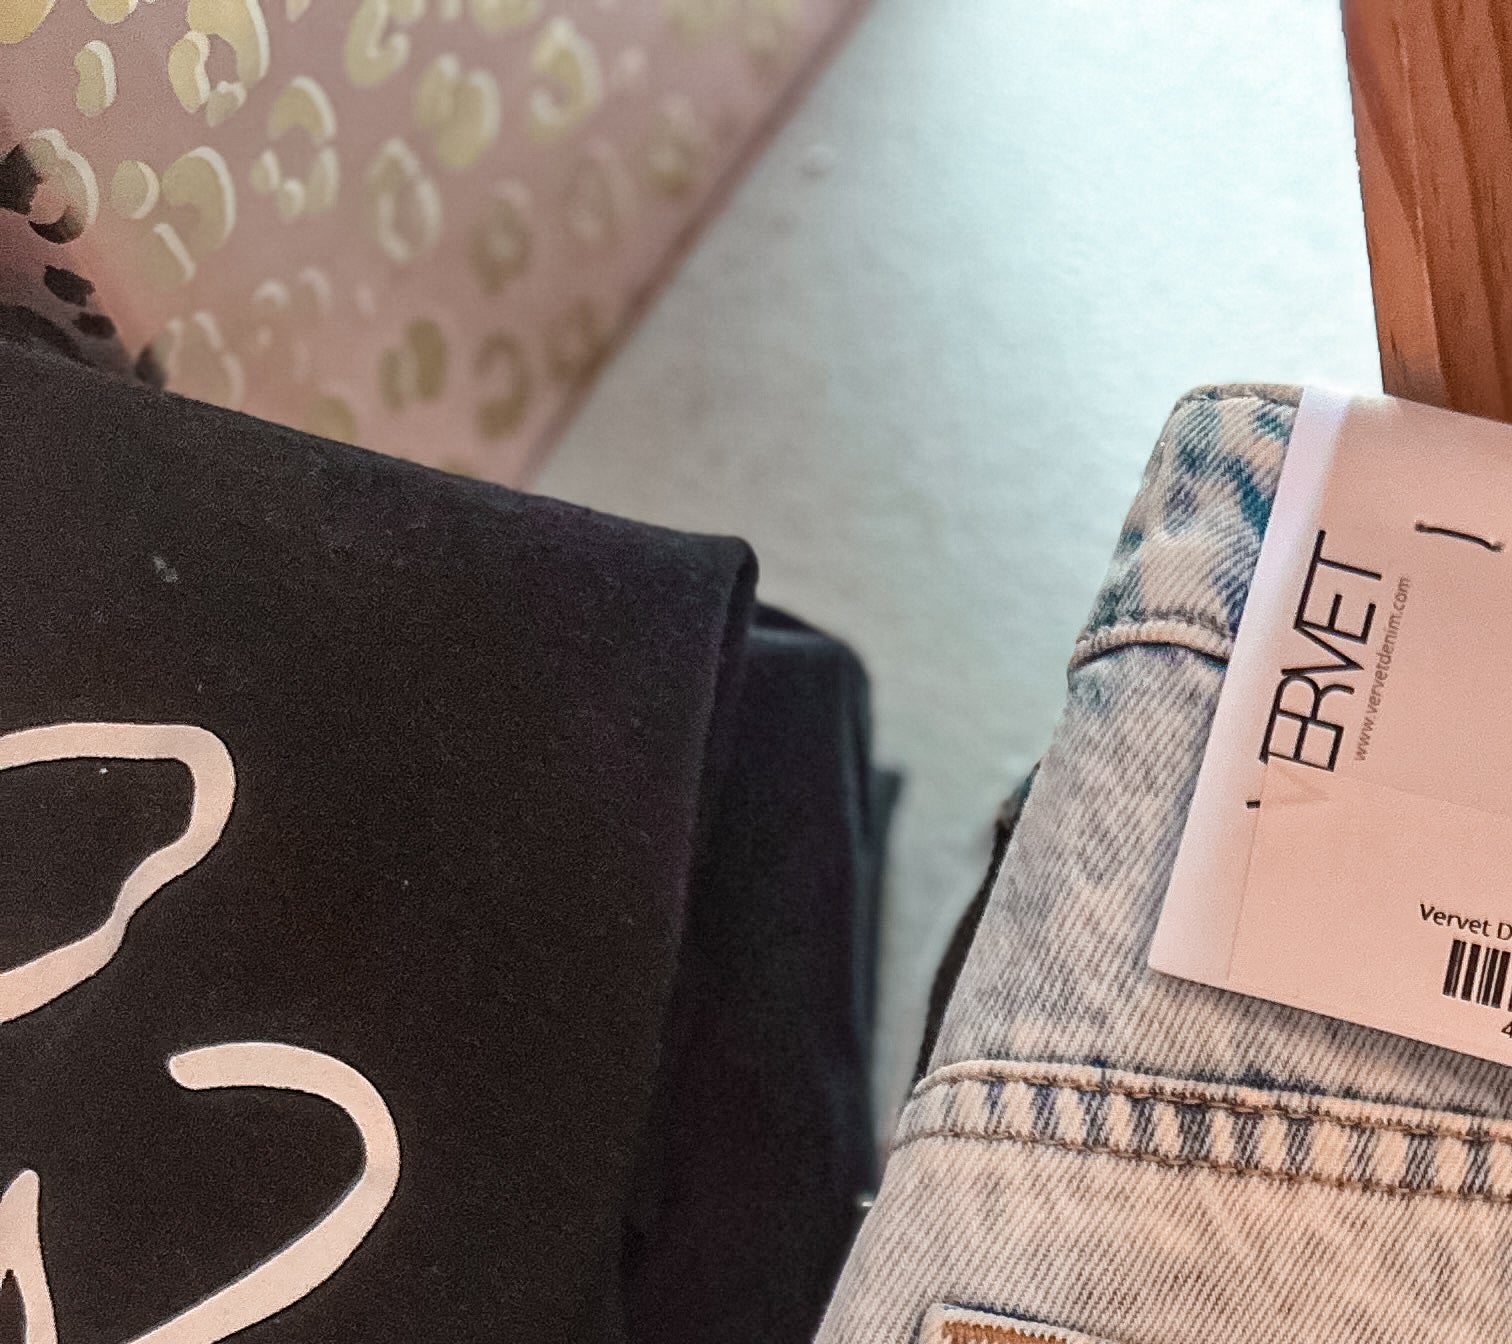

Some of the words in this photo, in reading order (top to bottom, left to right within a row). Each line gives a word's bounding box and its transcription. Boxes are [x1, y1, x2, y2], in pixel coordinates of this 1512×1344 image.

[1246, 529, 1382, 809] ERVET
[1353, 575, 1411, 762] www.vervetdenim.com
[1419, 903, 1491, 937] Vervet
